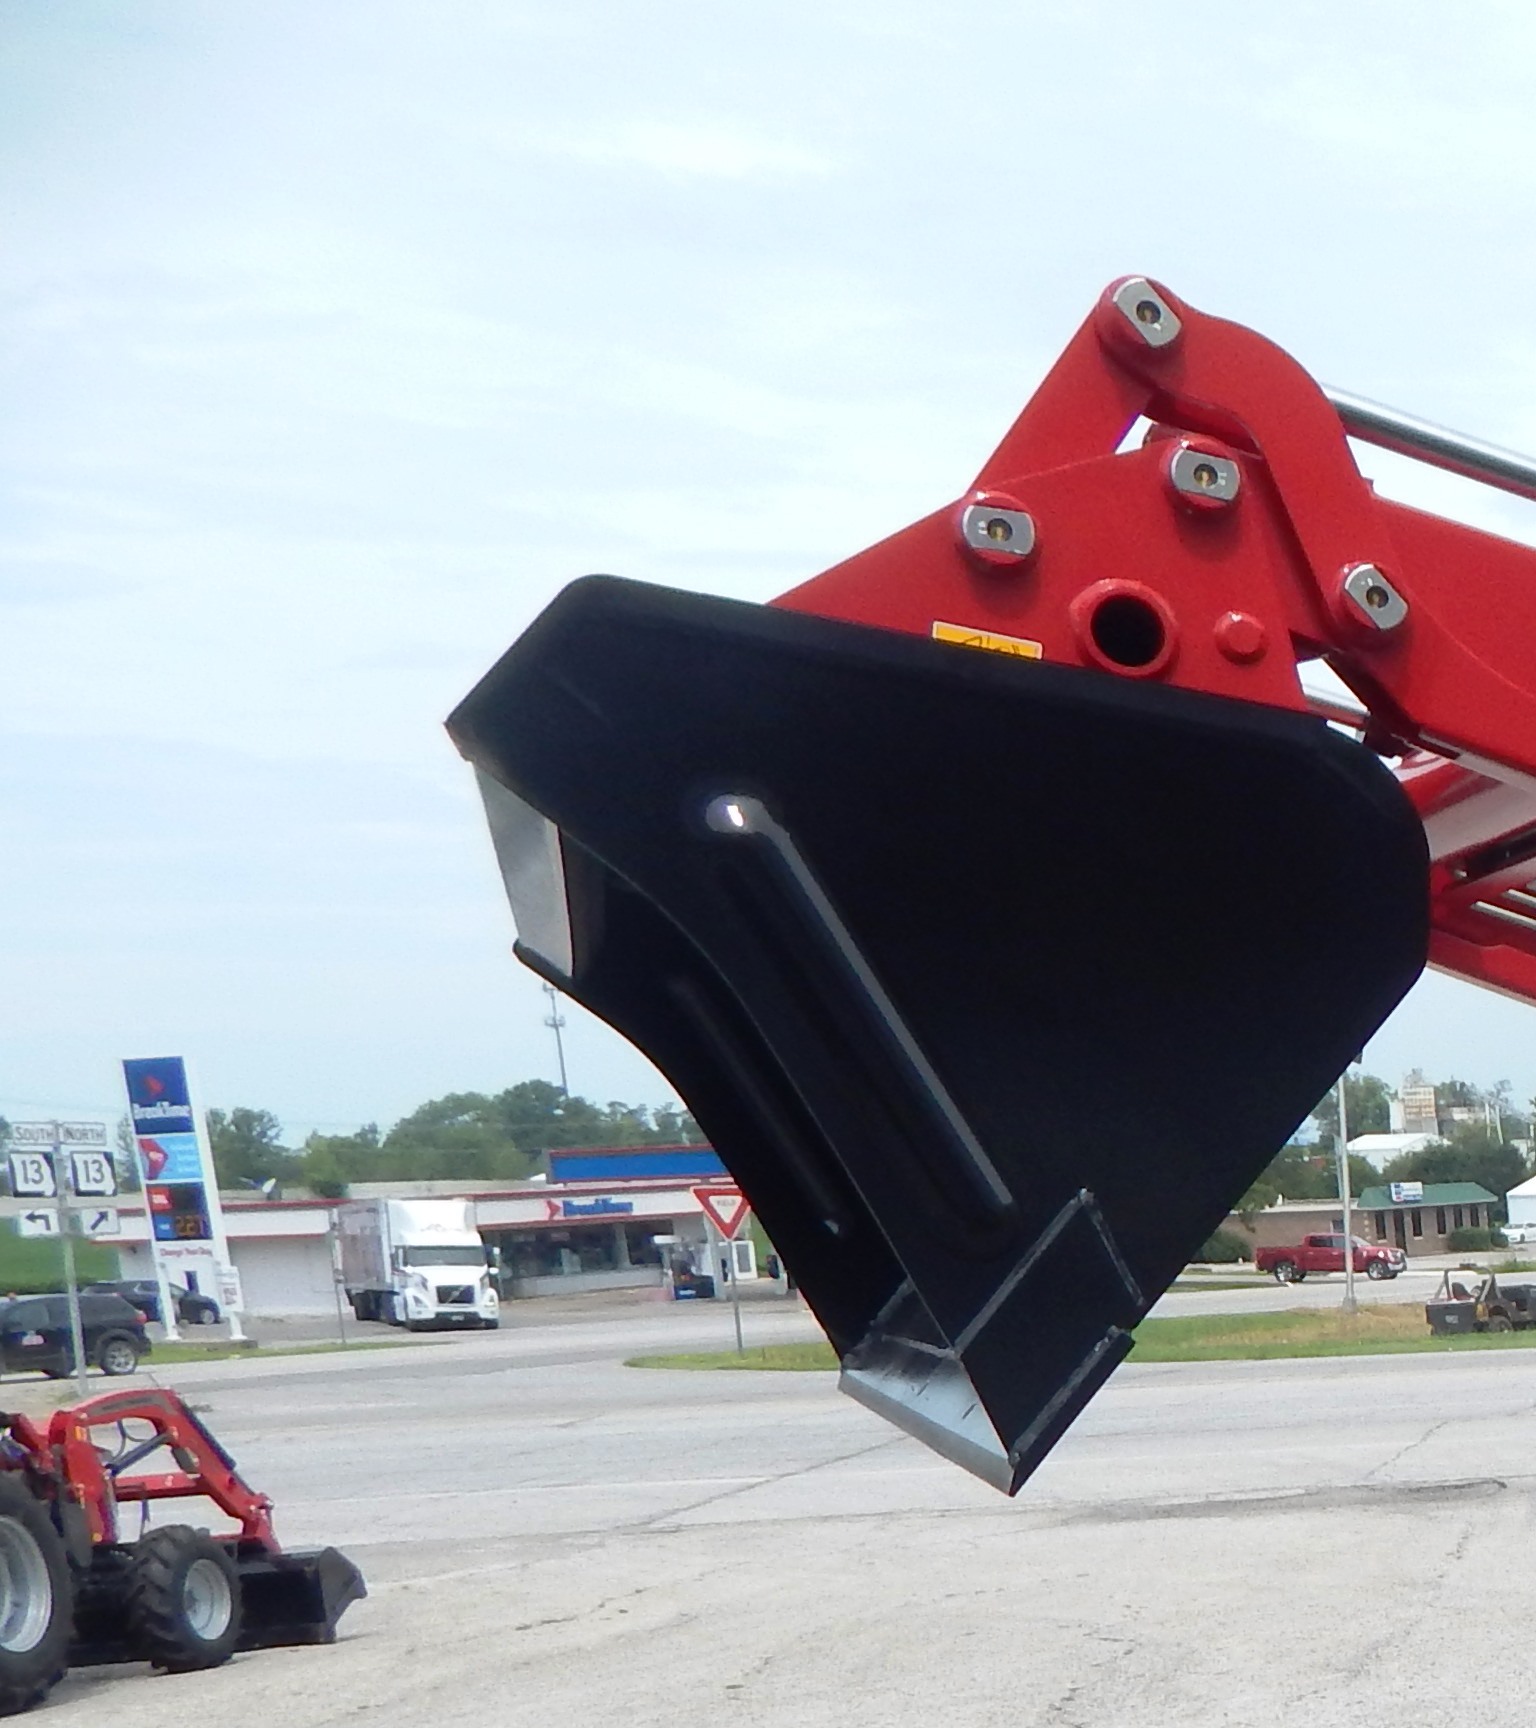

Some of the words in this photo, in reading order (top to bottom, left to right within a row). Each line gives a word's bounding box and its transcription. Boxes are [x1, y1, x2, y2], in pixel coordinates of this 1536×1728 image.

[15, 1127, 54, 1141] SOUTH
[63, 1128, 103, 1141] NORTH
[21, 1160, 44, 1184] 13
[84, 1160, 104, 1184] 13
